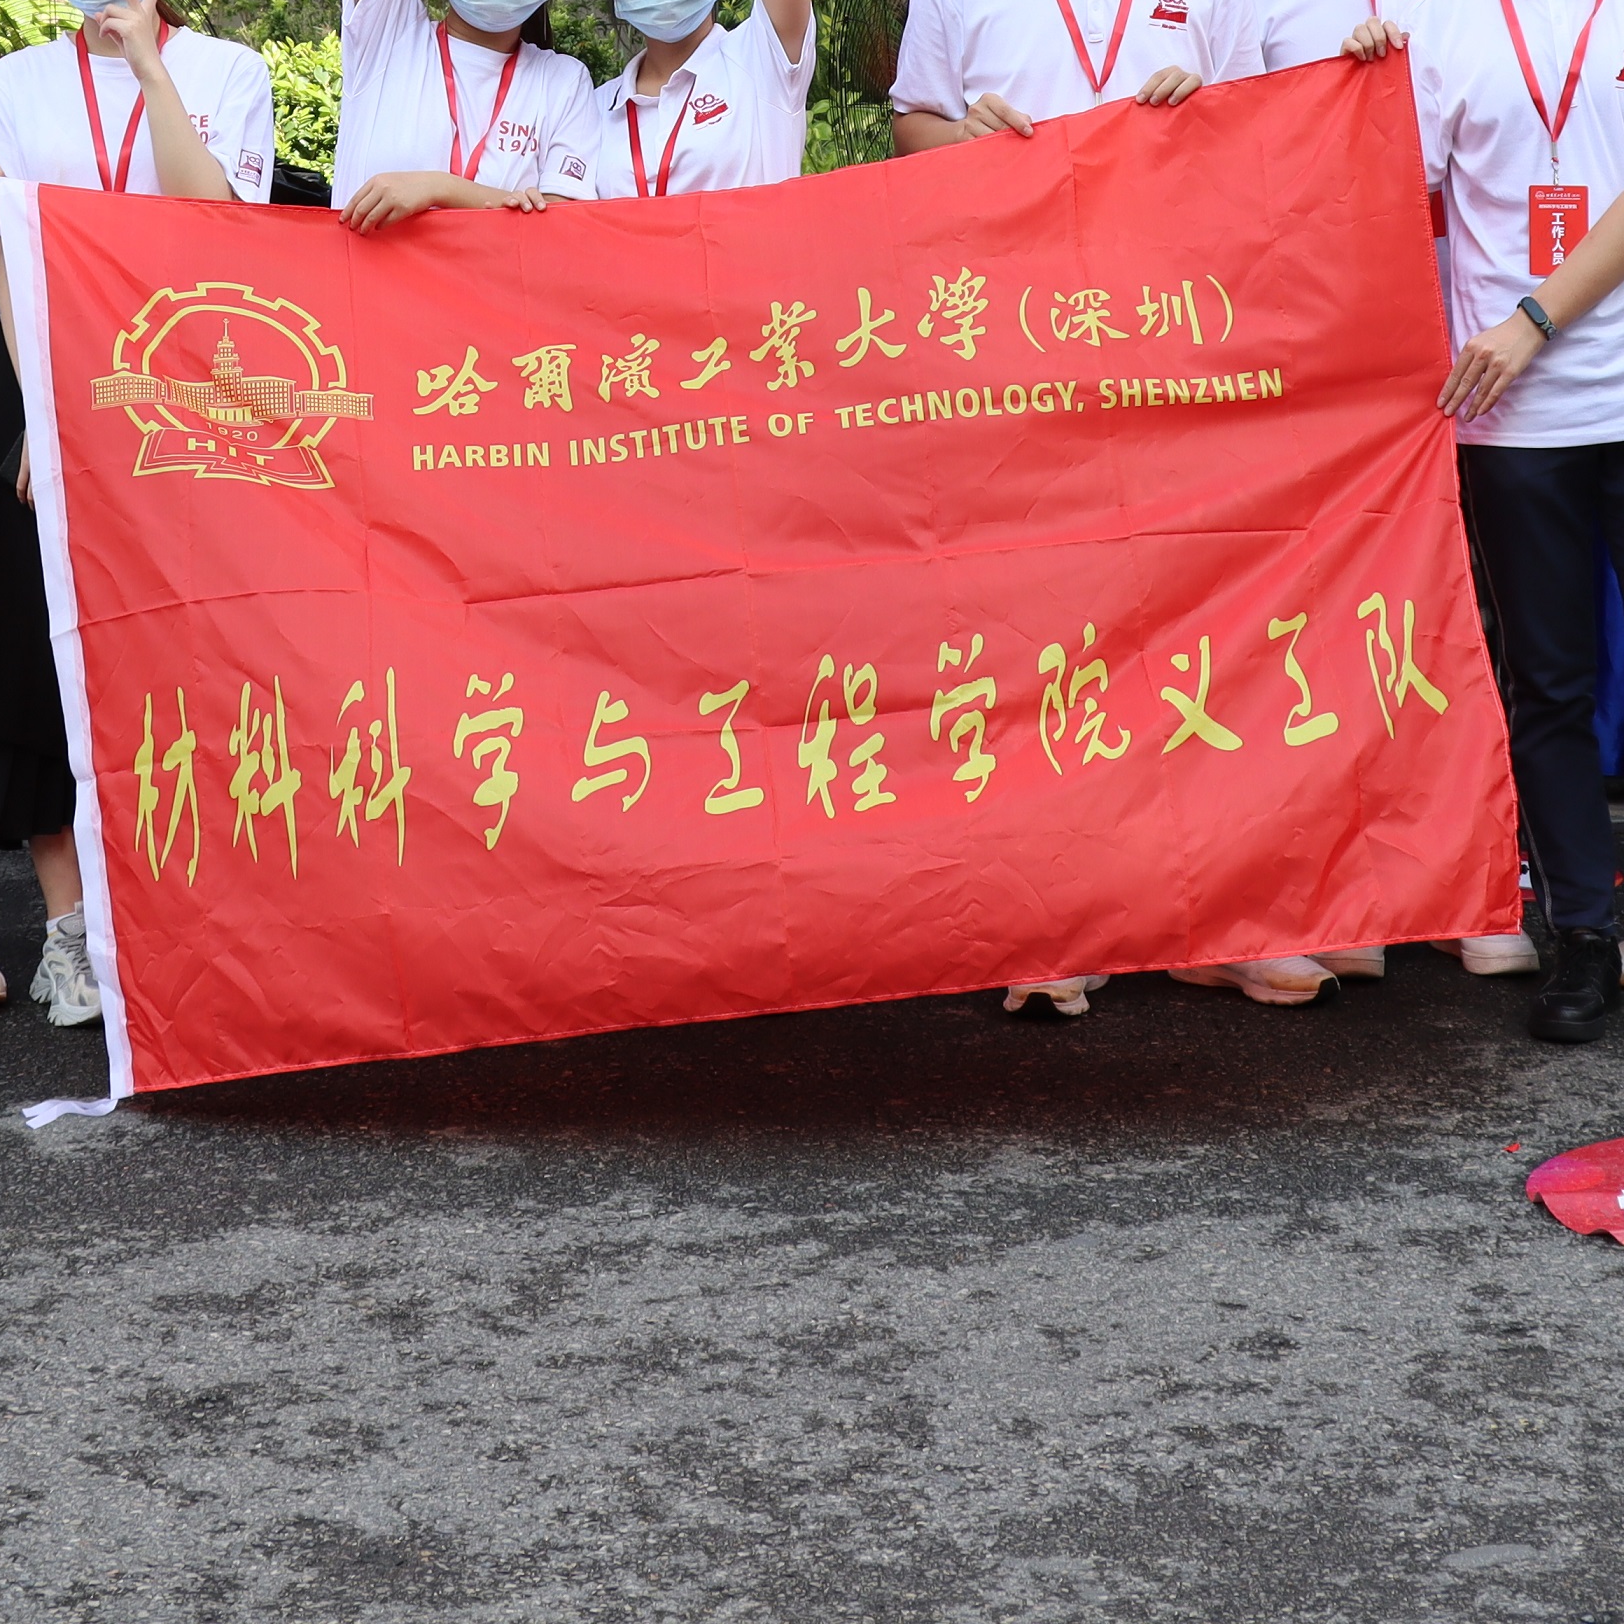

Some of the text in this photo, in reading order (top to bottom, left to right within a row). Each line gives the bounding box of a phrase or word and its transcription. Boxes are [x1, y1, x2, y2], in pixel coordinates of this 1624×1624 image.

[1551, 212, 1565, 266] 工作人员
[205, 420, 260, 443] 1920
[412, 367, 1283, 471] HARBIN INSTITUTE OF TECHNOLOGY, SHENZHEN
[186, 434, 277, 468] HIT
[132, 591, 1450, 889] 材料科学与工程学院义工队
